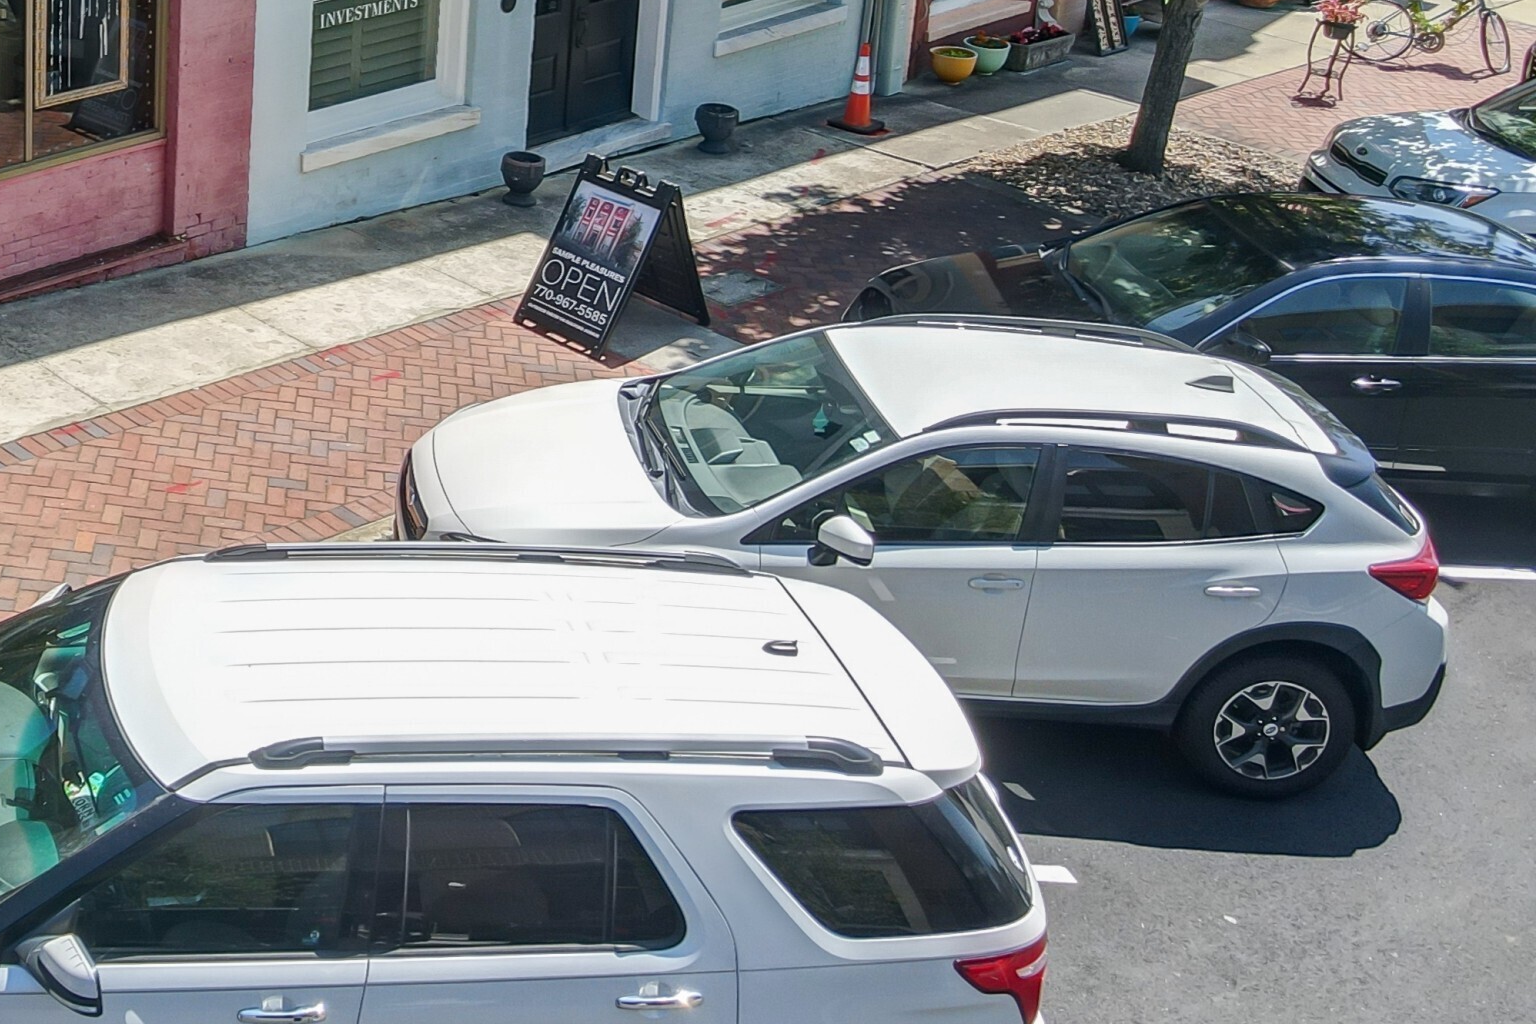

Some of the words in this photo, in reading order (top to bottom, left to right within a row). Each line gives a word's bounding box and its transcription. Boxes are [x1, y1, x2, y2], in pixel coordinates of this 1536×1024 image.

[541, 259, 622, 312] OPEN
[551, 247, 582, 266] SAMPLE
[580, 256, 626, 284] PLEASURES
[533, 283, 608, 326] 770-967-5585
